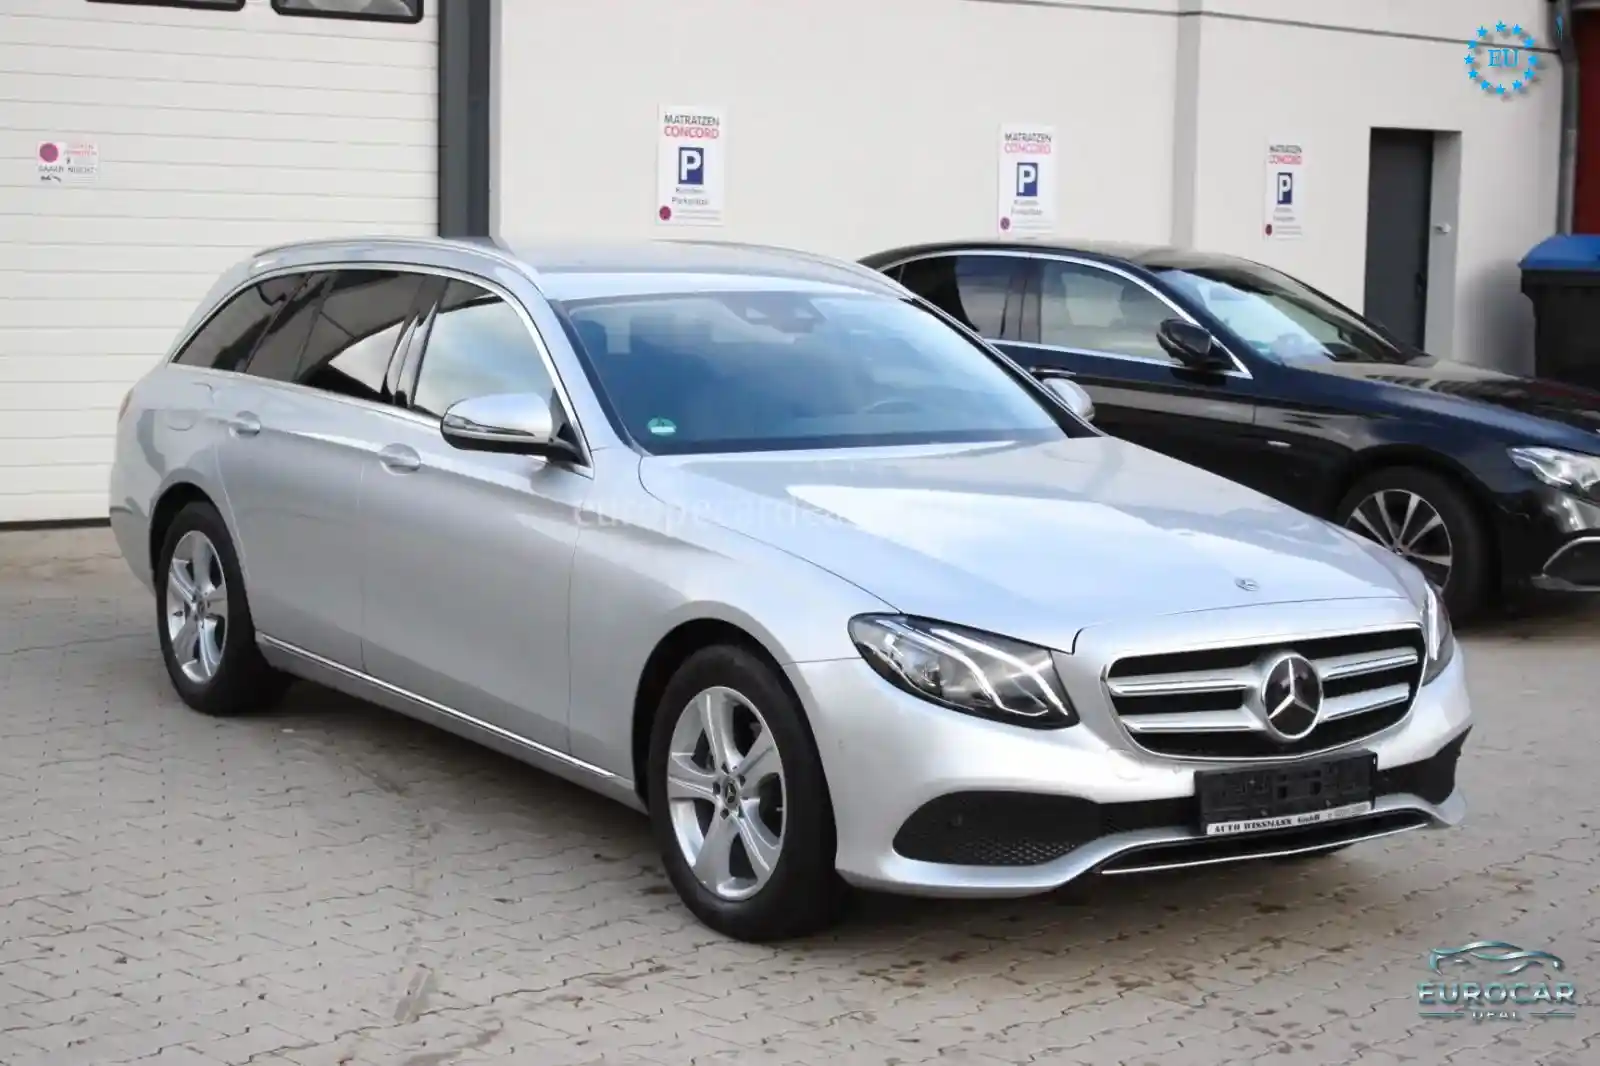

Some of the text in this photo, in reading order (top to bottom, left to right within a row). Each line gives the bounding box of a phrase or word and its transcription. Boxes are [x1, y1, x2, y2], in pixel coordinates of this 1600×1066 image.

[663, 113, 720, 126] MATRATZEN
[663, 125, 720, 140] CONCORD
[681, 150, 701, 181] P
[1018, 165, 1036, 194] P
[1280, 175, 1291, 201] P
